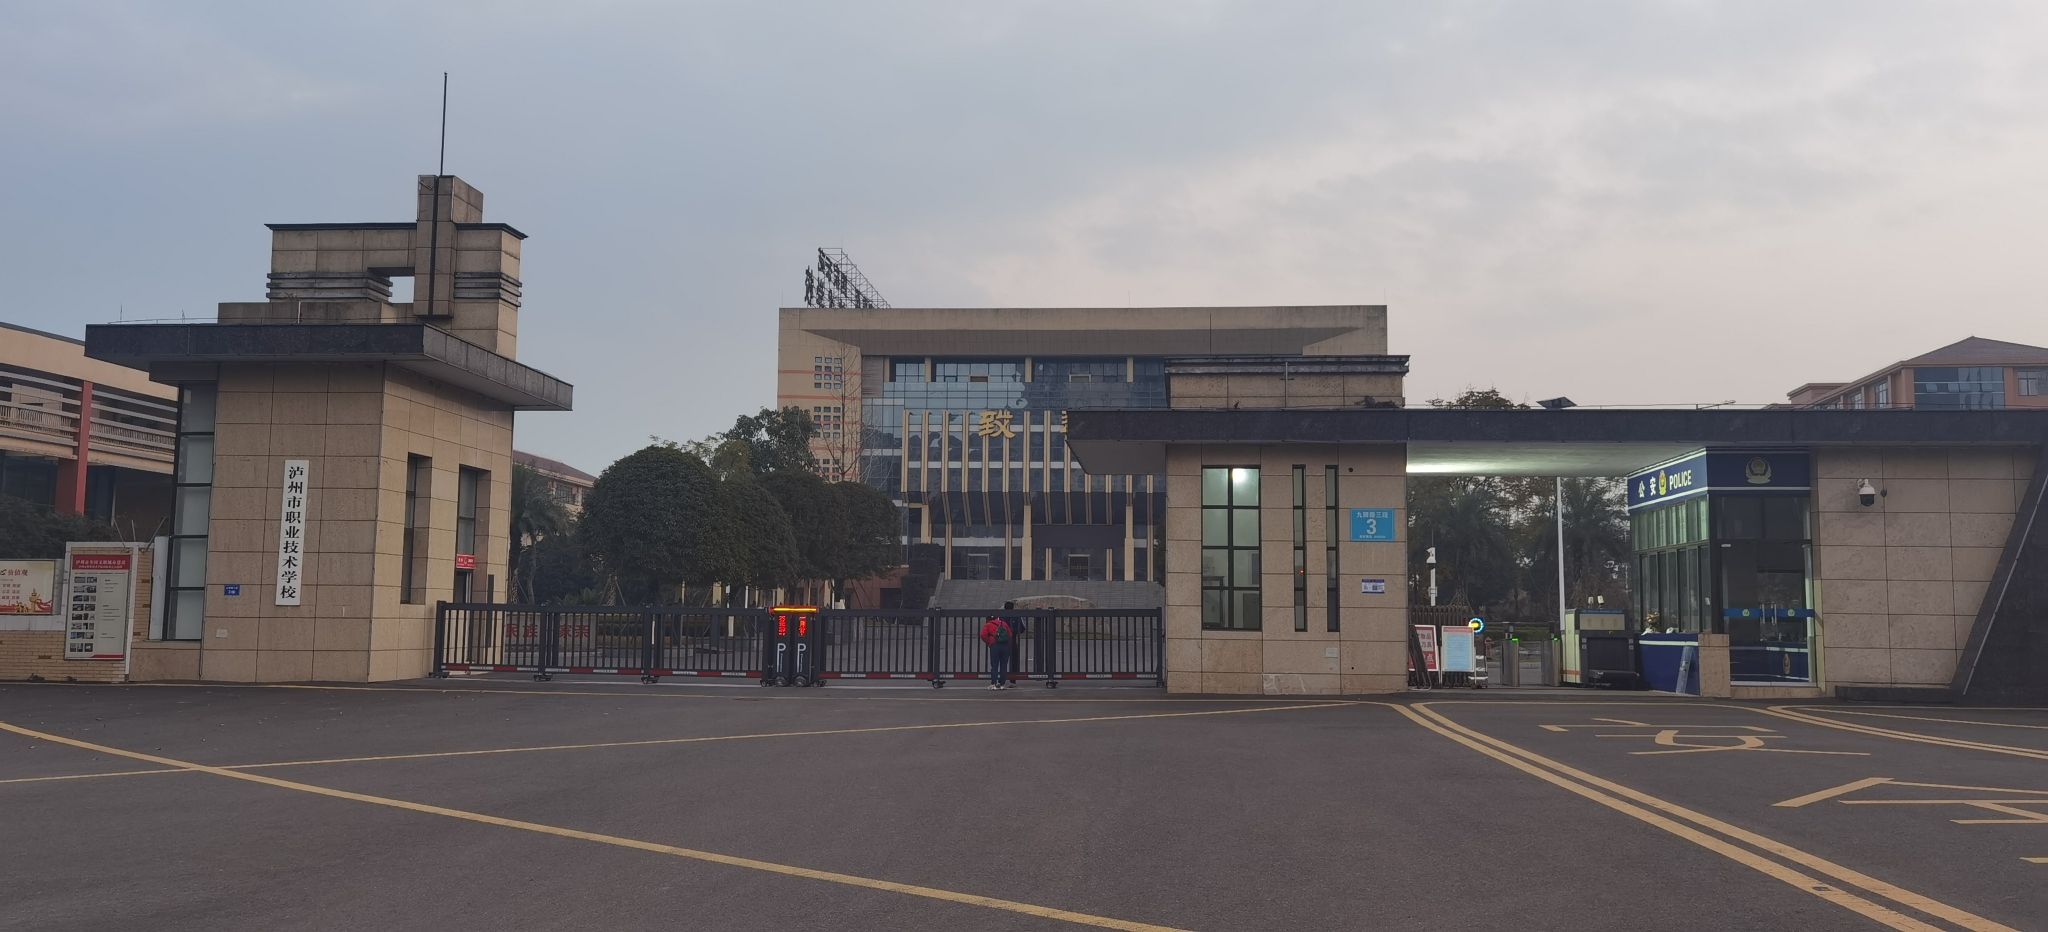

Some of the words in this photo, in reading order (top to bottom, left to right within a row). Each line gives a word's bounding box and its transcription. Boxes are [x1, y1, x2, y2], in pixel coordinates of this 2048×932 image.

[1638, 476, 1656, 498] 公安
[1669, 469, 1692, 491] POLICE
[280, 466, 304, 599] 泸州市职业技术学校
[1366, 518, 1377, 535] 3
